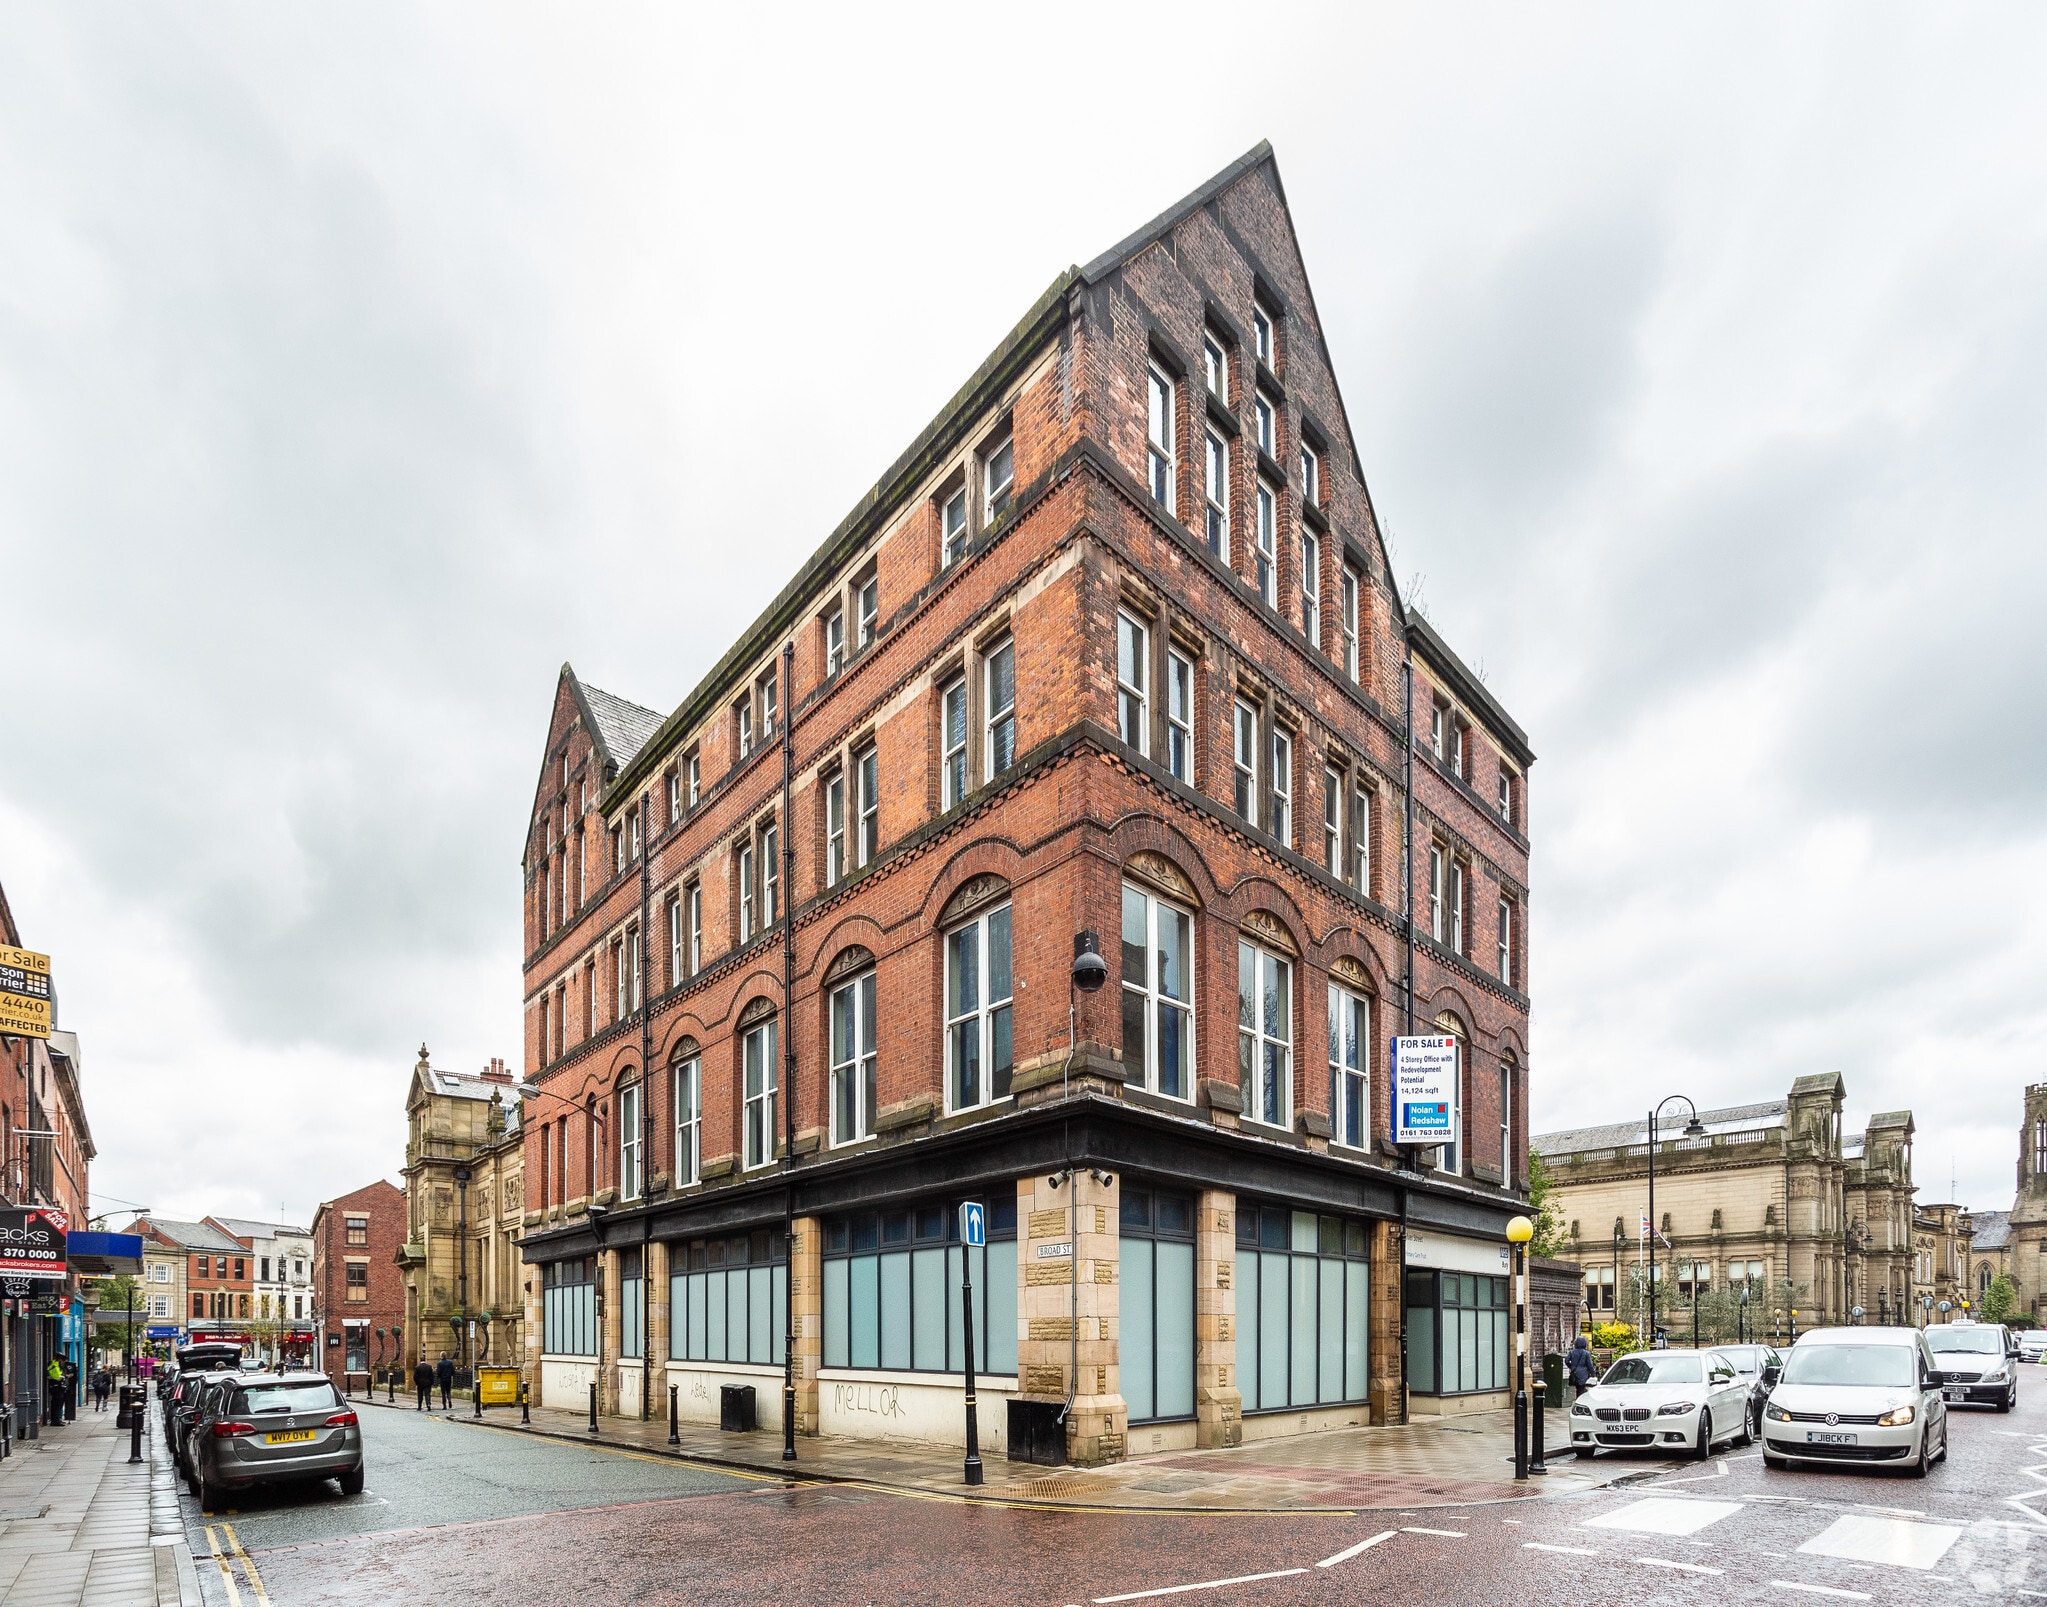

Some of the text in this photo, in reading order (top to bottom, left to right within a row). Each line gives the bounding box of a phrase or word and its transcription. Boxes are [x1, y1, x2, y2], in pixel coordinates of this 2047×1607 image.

[13, 951, 45, 970] Sale
[2, 996, 44, 1013] 4440
[0, 1006, 43, 1021] rier.co.uk
[0, 1017, 47, 1034] AFFECTED
[1401, 1038, 1443, 1049] FOR SALE
[1405, 1055, 1422, 1064] Storey
[1424, 1055, 1440, 1063] Office
[1441, 1054, 1453, 1062] with
[1401, 1065, 1441, 1074] Redevelopment
[1401, 1076, 1425, 1084] Potential
[1425, 1087, 1439, 1095] sqft
[1411, 1106, 1433, 1114] Nolan
[1411, 1116, 1446, 1125] Redshaw
[44, 1210, 68, 1230] FOR SALE
[3, 1247, 57, 1260] 370 0000
[1040, 1245, 1061, 1256] BROAD
[1625, 1424, 1639, 1432] EPC
[1844, 1435, 1850, 1443] F
